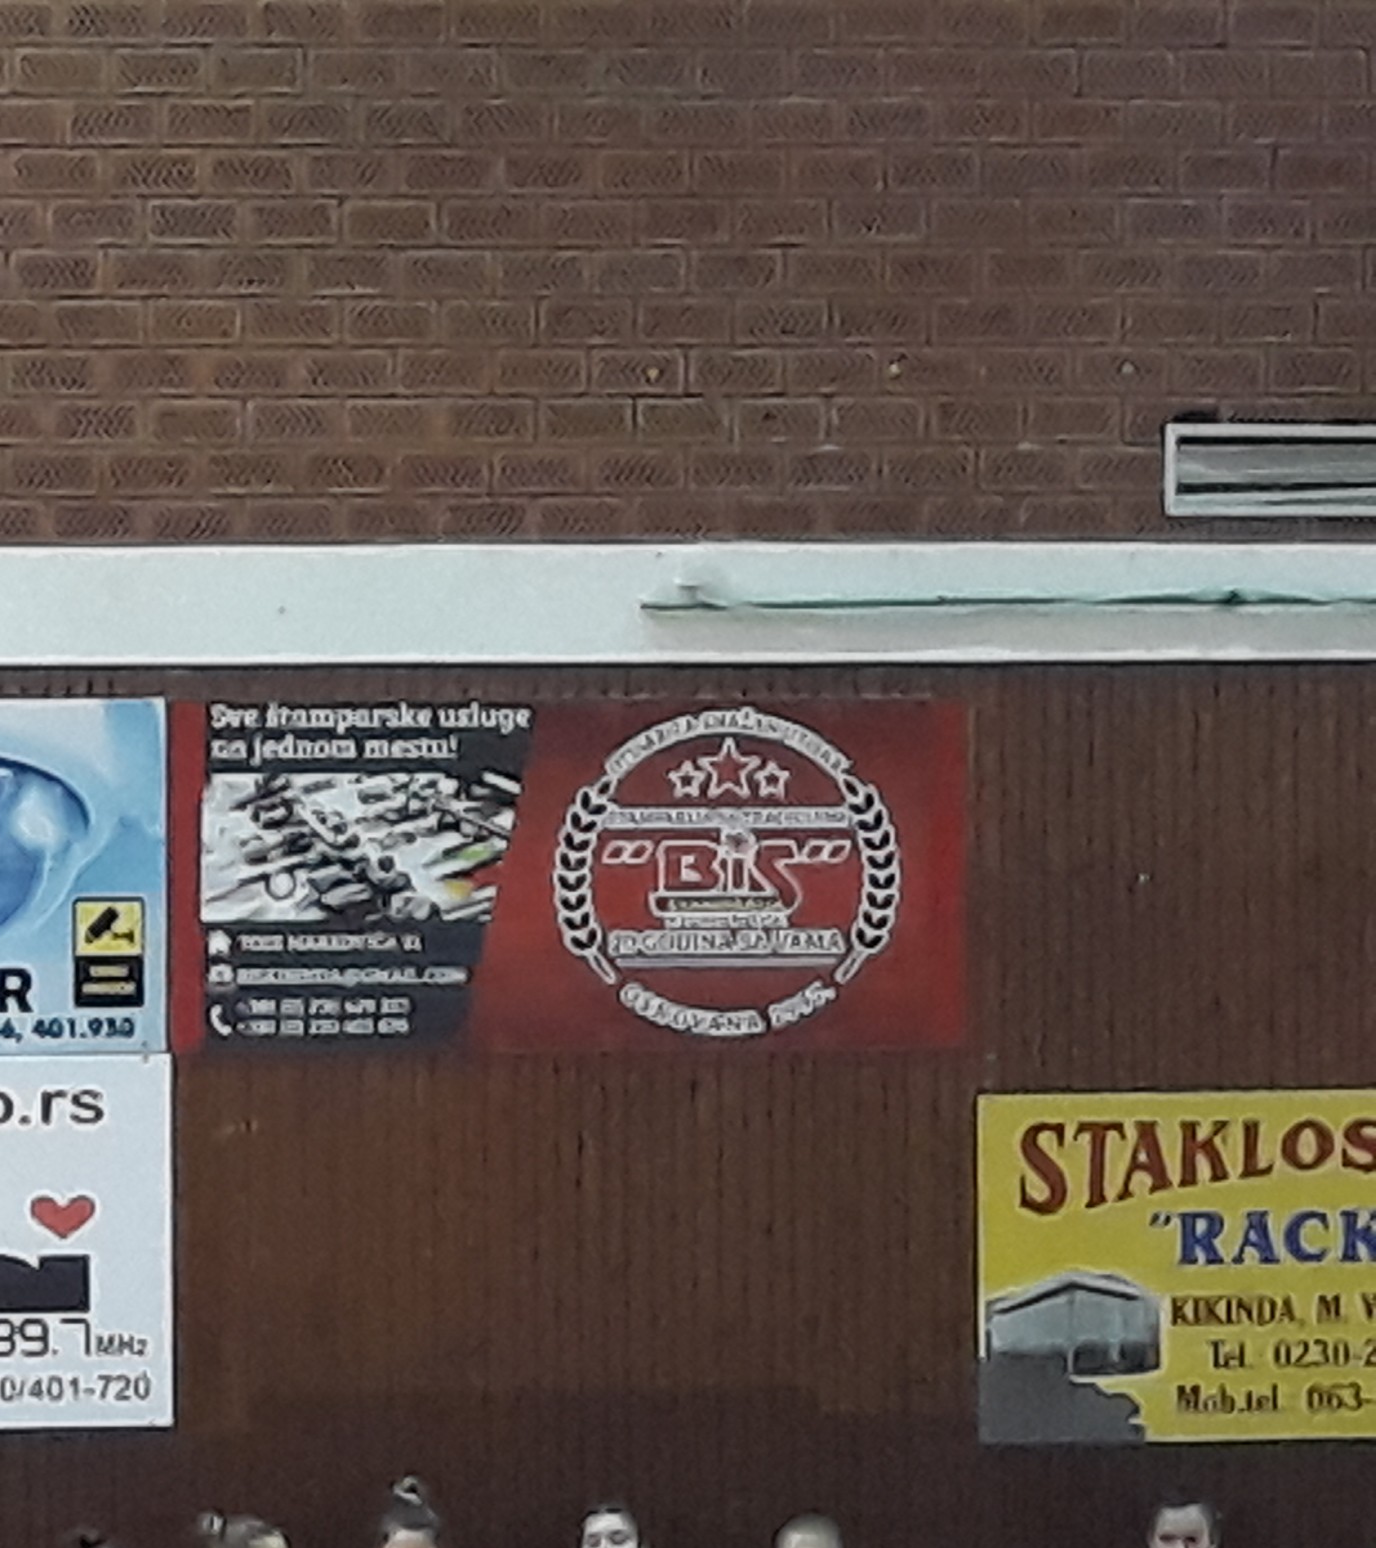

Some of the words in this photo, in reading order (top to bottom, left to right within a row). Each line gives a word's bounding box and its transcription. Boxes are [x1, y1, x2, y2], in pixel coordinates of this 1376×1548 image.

[210, 703, 260, 729] Sve
[439, 701, 532, 734] usluge
[250, 734, 358, 767] jednom
[363, 736, 459, 760] mestu!
[94, 1333, 149, 1358] MHz
